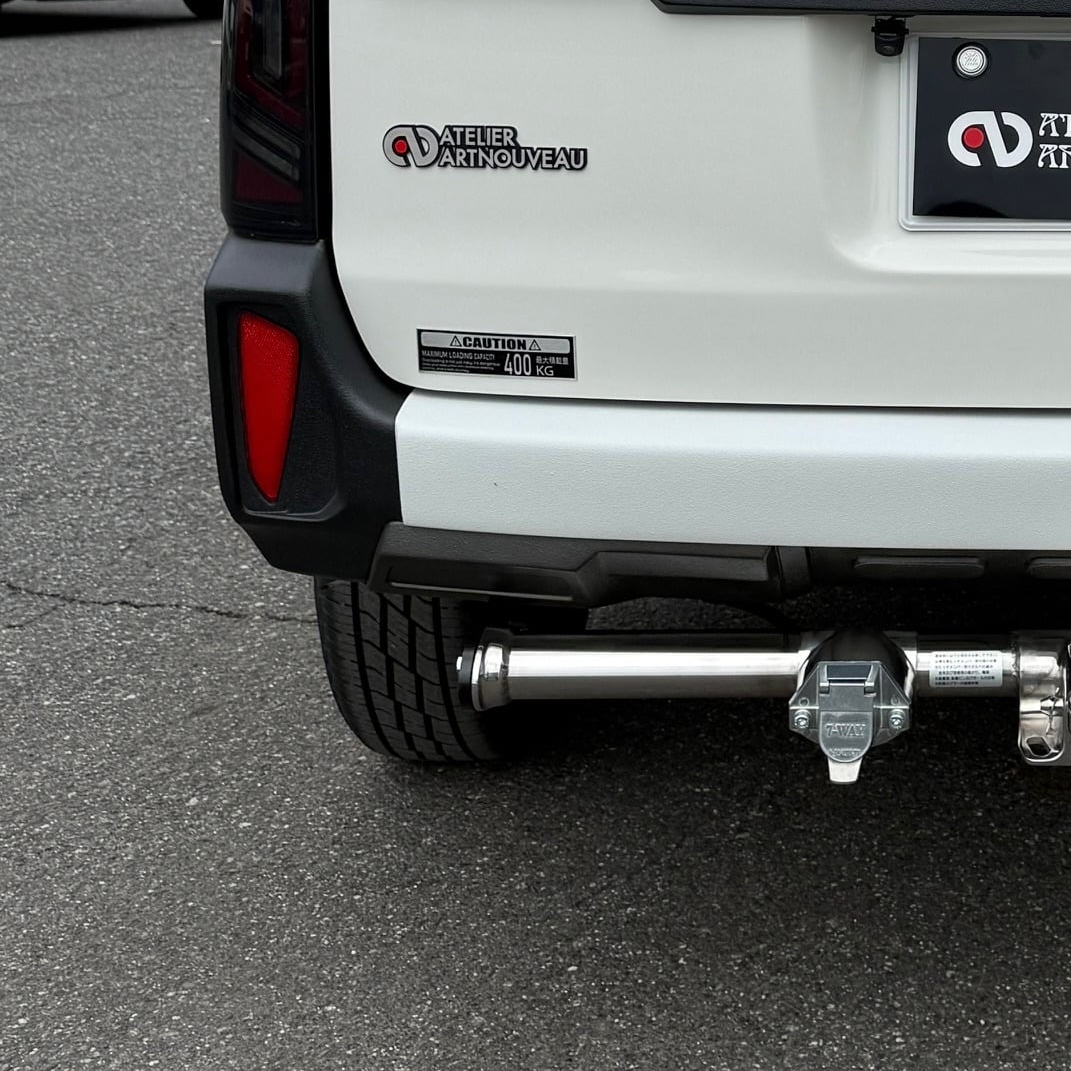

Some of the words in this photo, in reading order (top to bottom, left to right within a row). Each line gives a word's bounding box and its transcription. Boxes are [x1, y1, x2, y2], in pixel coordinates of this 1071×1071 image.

[439, 126, 517, 147] ATELIER
[438, 147, 587, 170] ARTNOUVEAU
[462, 336, 527, 351] CAUTION
[421, 350, 448, 359] MAXIMUM
[449, 351, 473, 360] LOADING
[504, 353, 532, 376] 400
[536, 365, 555, 376] KG
